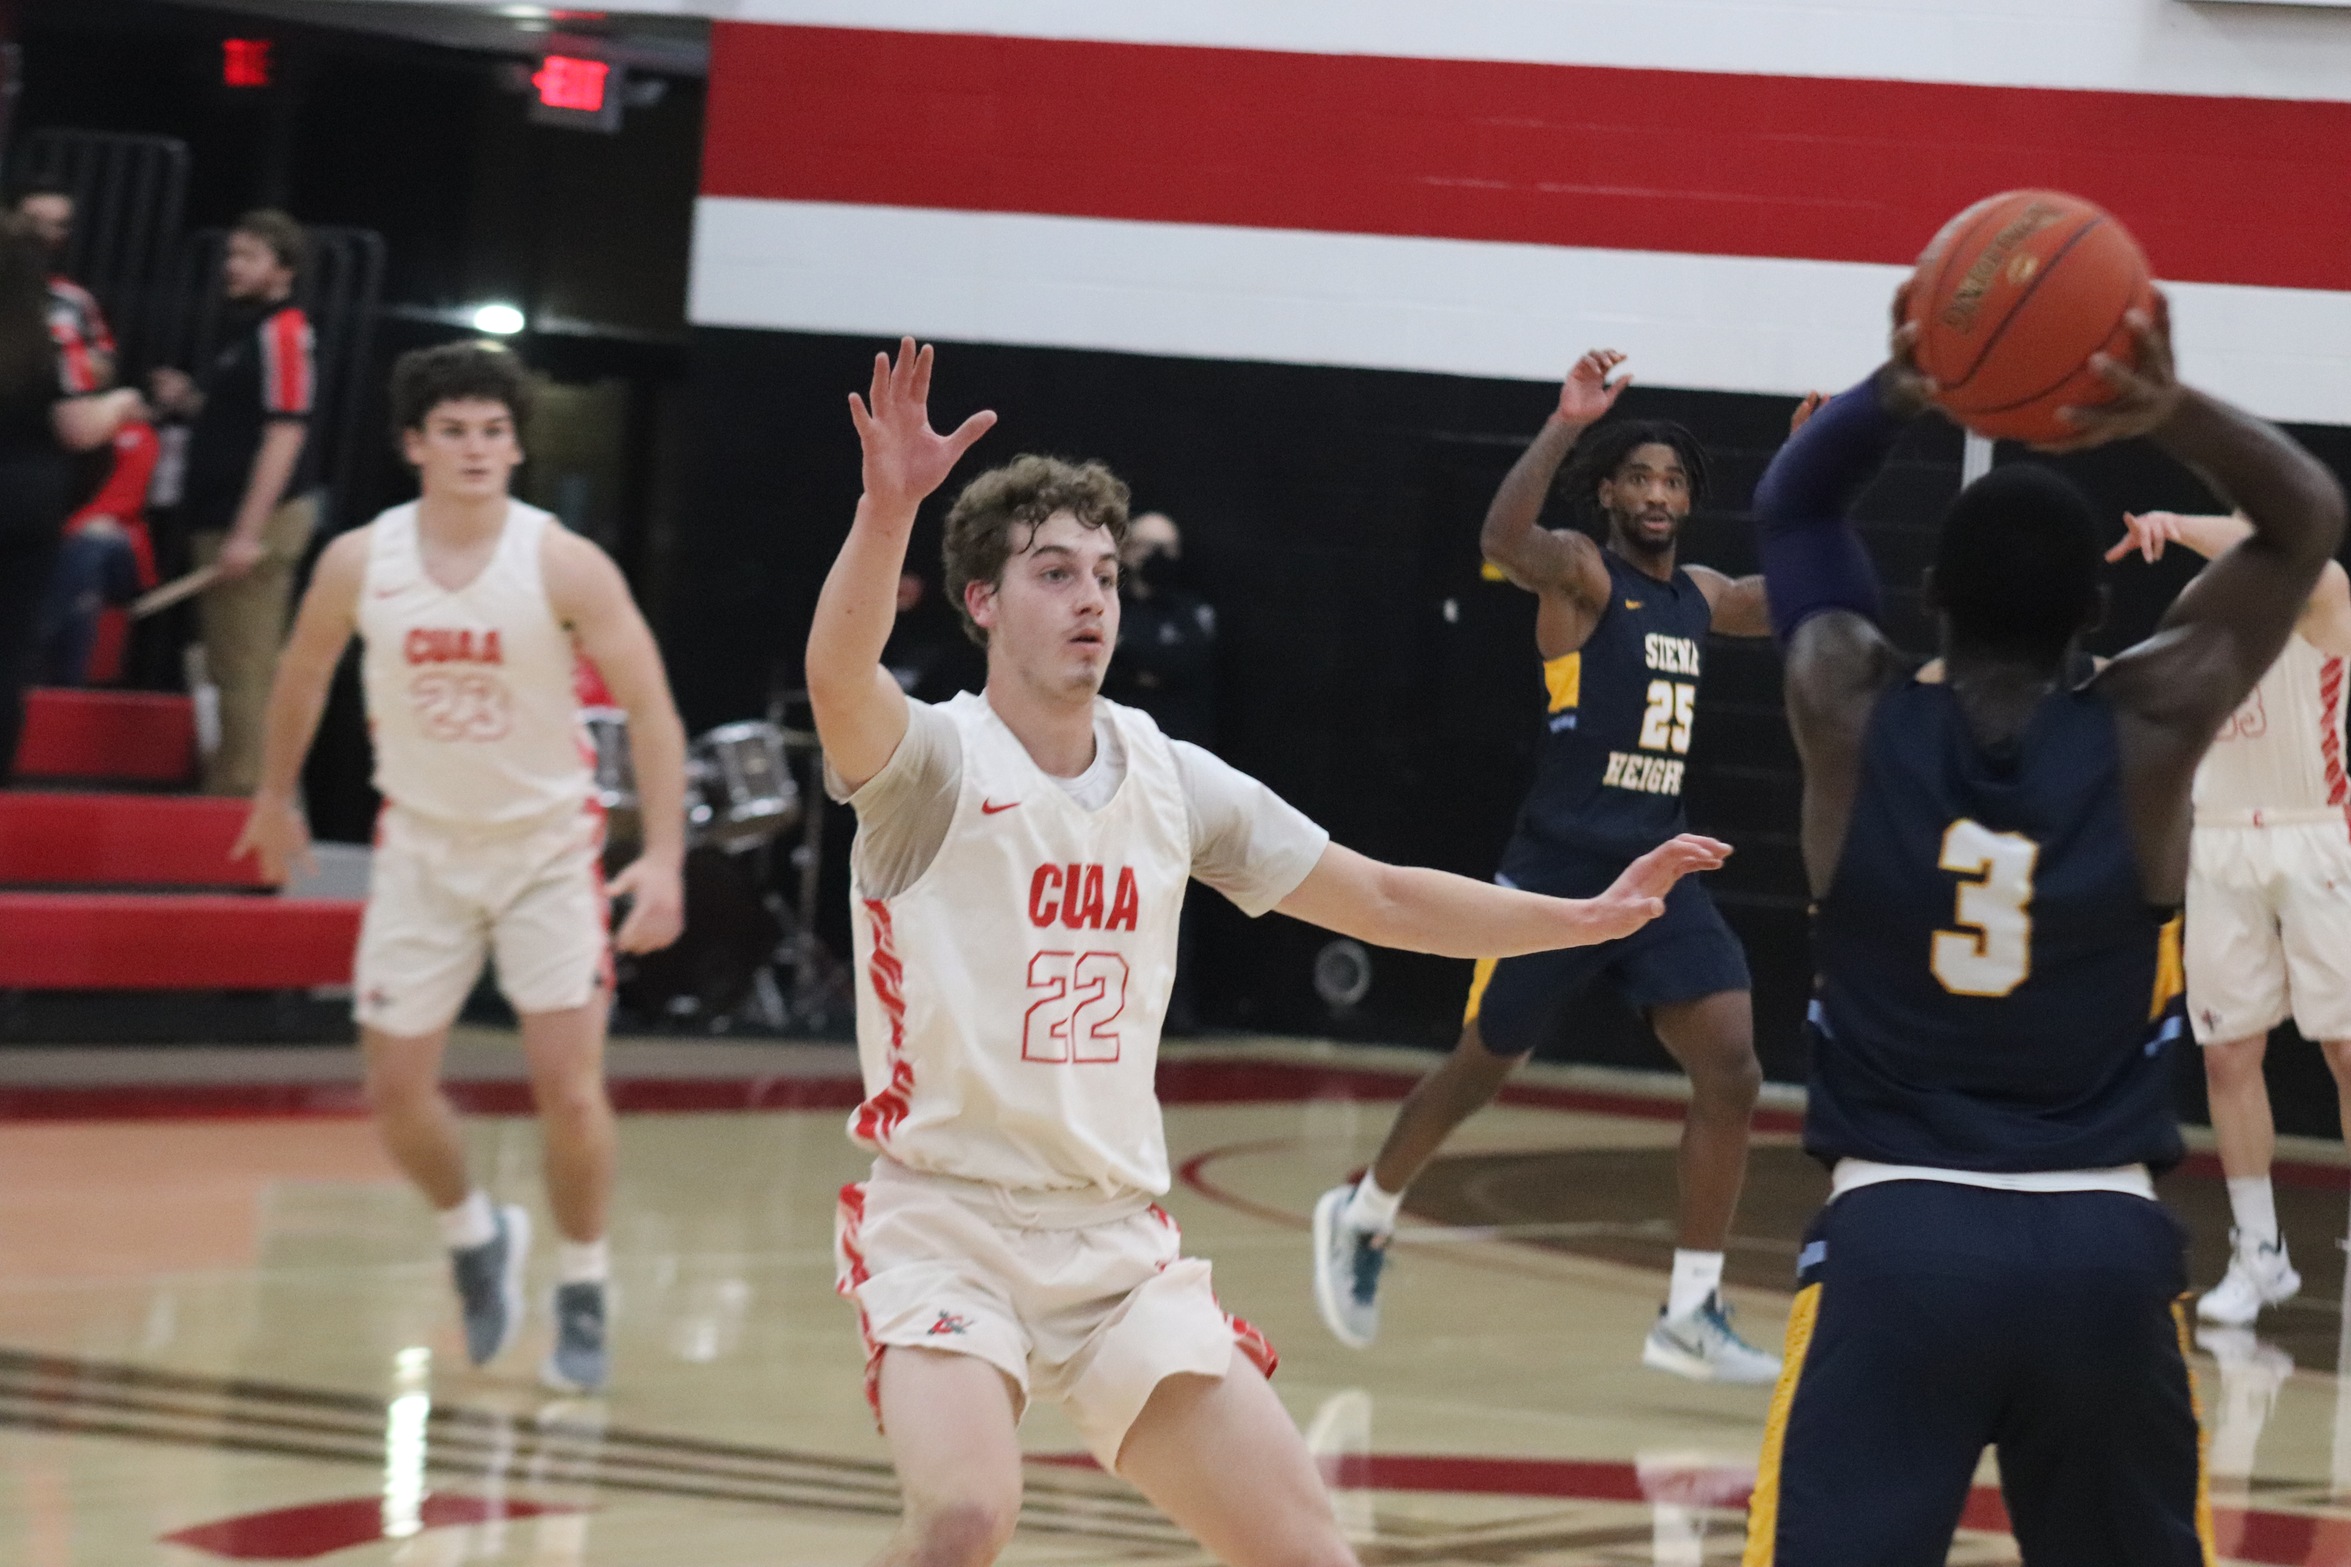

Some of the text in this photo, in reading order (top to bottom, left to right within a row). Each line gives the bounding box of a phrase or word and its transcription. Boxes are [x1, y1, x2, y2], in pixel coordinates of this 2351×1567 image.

[404, 627, 504, 666] CUAA
[1637, 678, 1696, 755] 25
[1028, 863, 1139, 932] CUAA
[1930, 817, 2041, 997] 3
[1021, 950, 1130, 1064] 22
